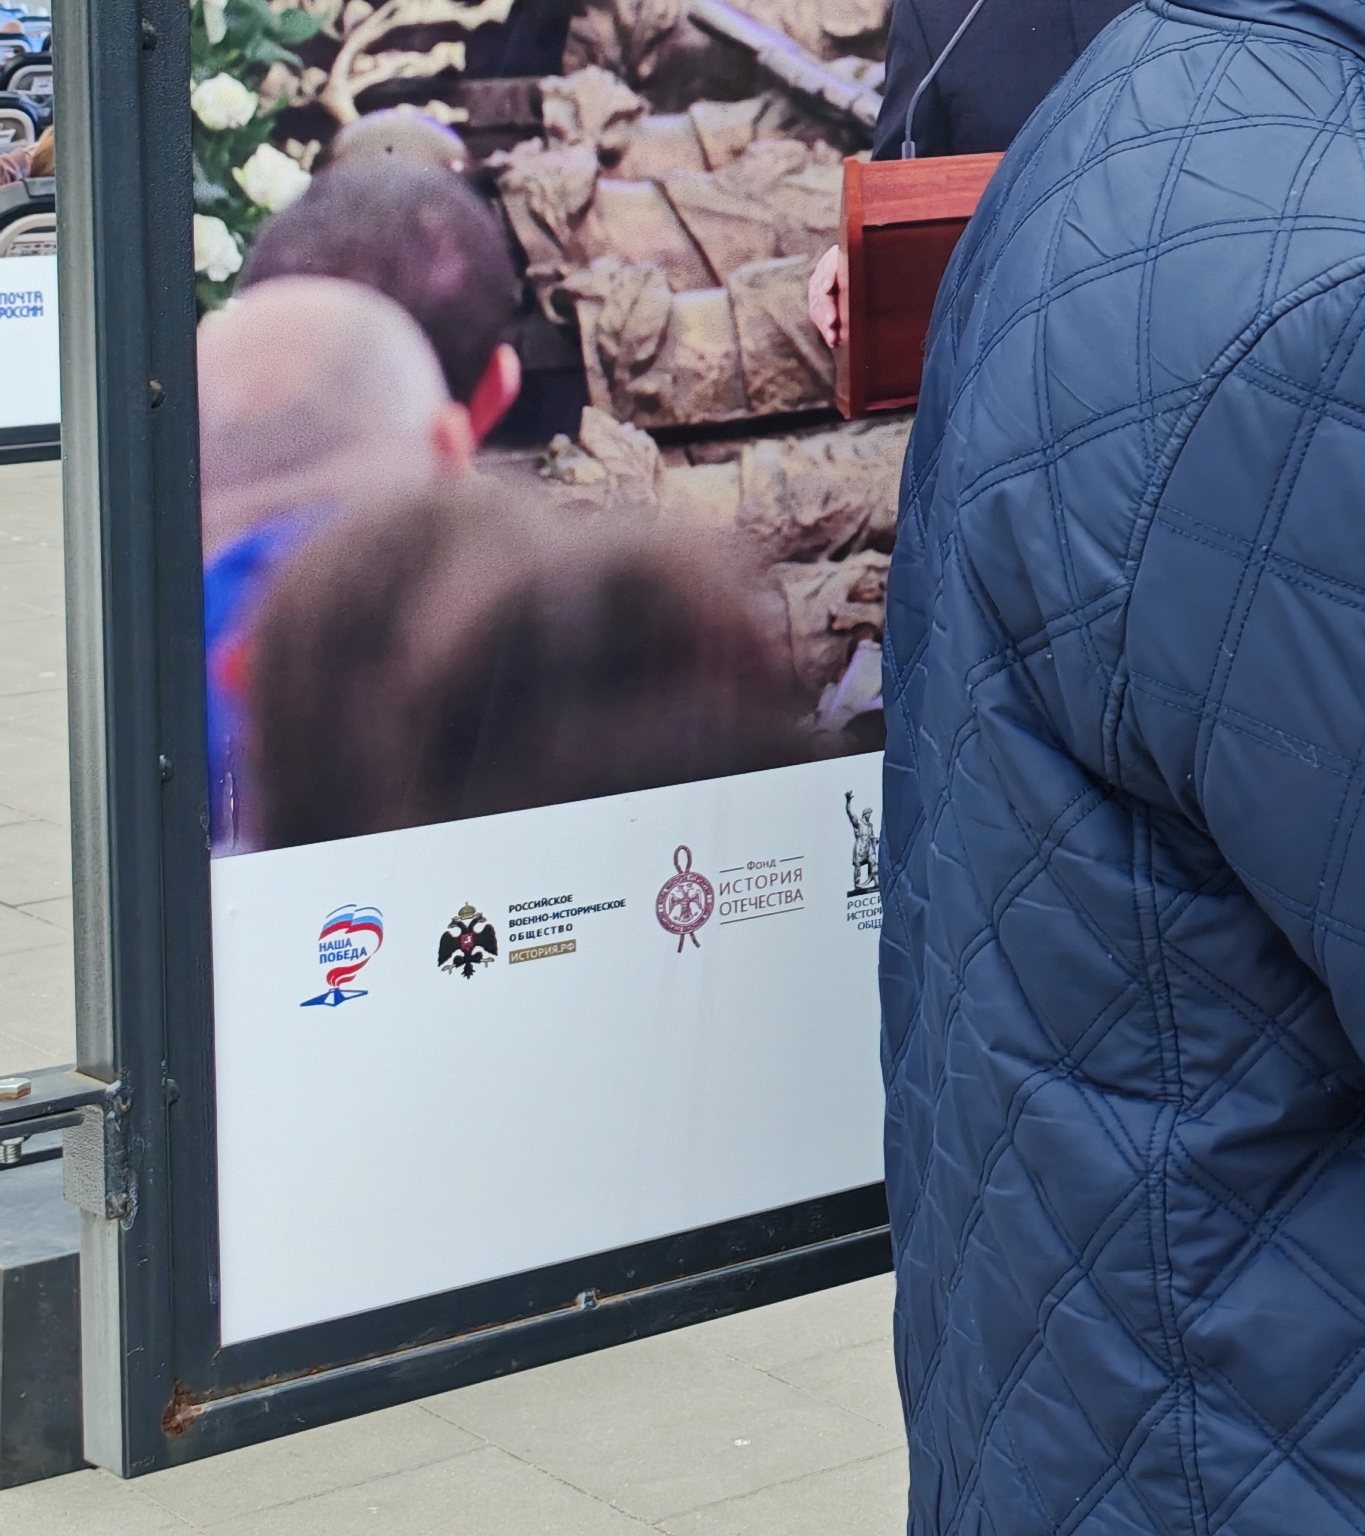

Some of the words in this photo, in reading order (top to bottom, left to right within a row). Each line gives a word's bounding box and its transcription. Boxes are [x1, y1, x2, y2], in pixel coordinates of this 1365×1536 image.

[719, 867, 804, 896] ИСТОРИЯ
[508, 894, 573, 913] РОССИЙСКОЕ
[719, 888, 804, 916] ОТЕЧЕСТВА
[508, 898, 627, 928] ВОЕННО-ИСТОРИЧЕСКОЕ
[509, 923, 573, 942] ОБЩЕСТВО
[319, 937, 352, 952] НАША
[510, 942, 575, 962] ИСТОРИЯ.РФ
[319, 946, 367, 964] ПОБЕДА
